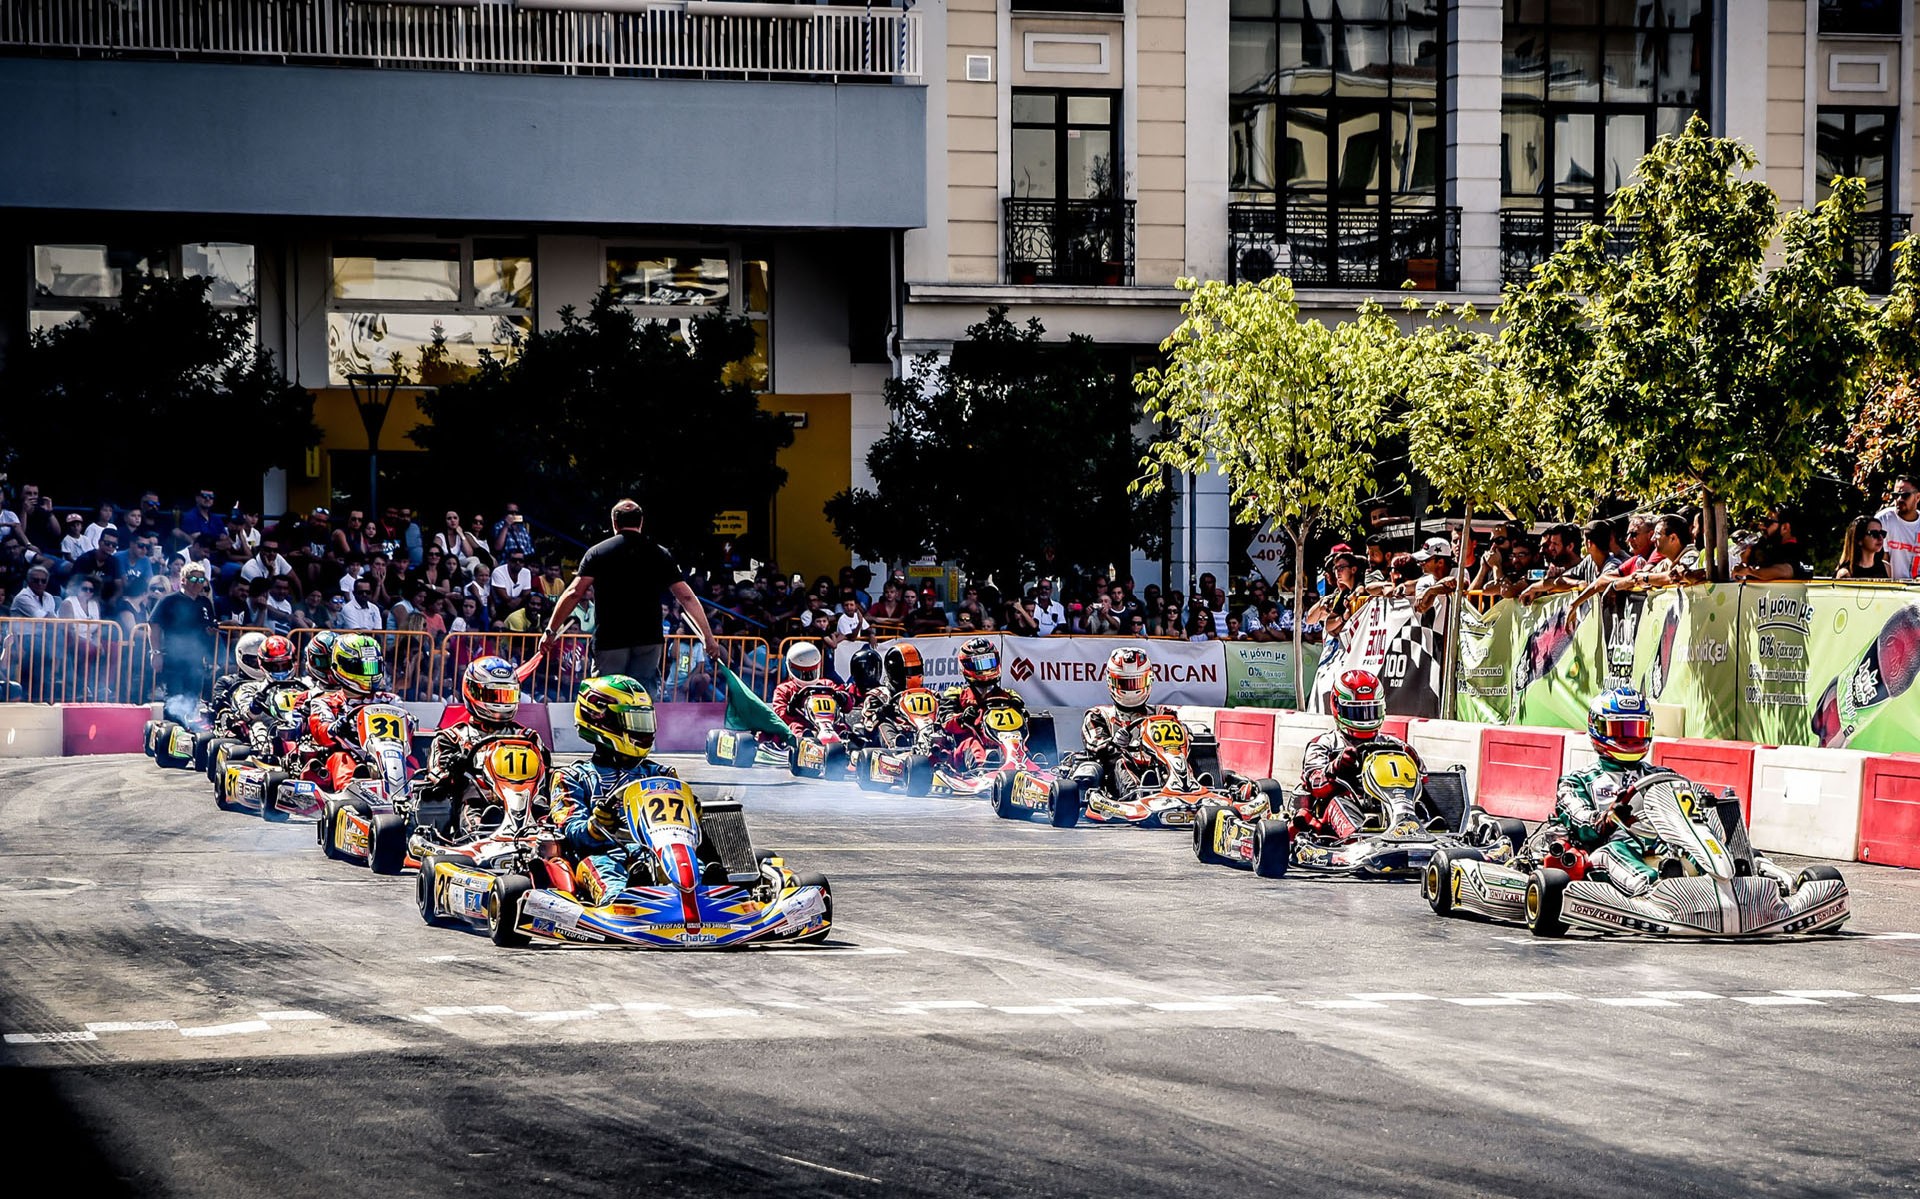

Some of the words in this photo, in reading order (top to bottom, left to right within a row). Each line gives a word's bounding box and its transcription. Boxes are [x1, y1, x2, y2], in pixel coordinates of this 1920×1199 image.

[1770, 595, 1797, 618] μόνη
[1798, 603, 1814, 621] με
[1250, 648, 1272, 660] μόνη
[1275, 652, 1287, 660] με
[1384, 655, 1407, 677] 100
[816, 699, 831, 711] 10
[910, 697, 932, 712] 171
[371, 716, 400, 738] 31
[994, 712, 1014, 726] 21
[1150, 723, 1183, 743] 629
[504, 751, 528, 775] 17
[1389, 761, 1399, 778] 1
[648, 797, 685, 824] 27
[1680, 794, 1705, 824] 2
[1454, 869, 1462, 905] 2
[680, 934, 717, 942] Chatzis
